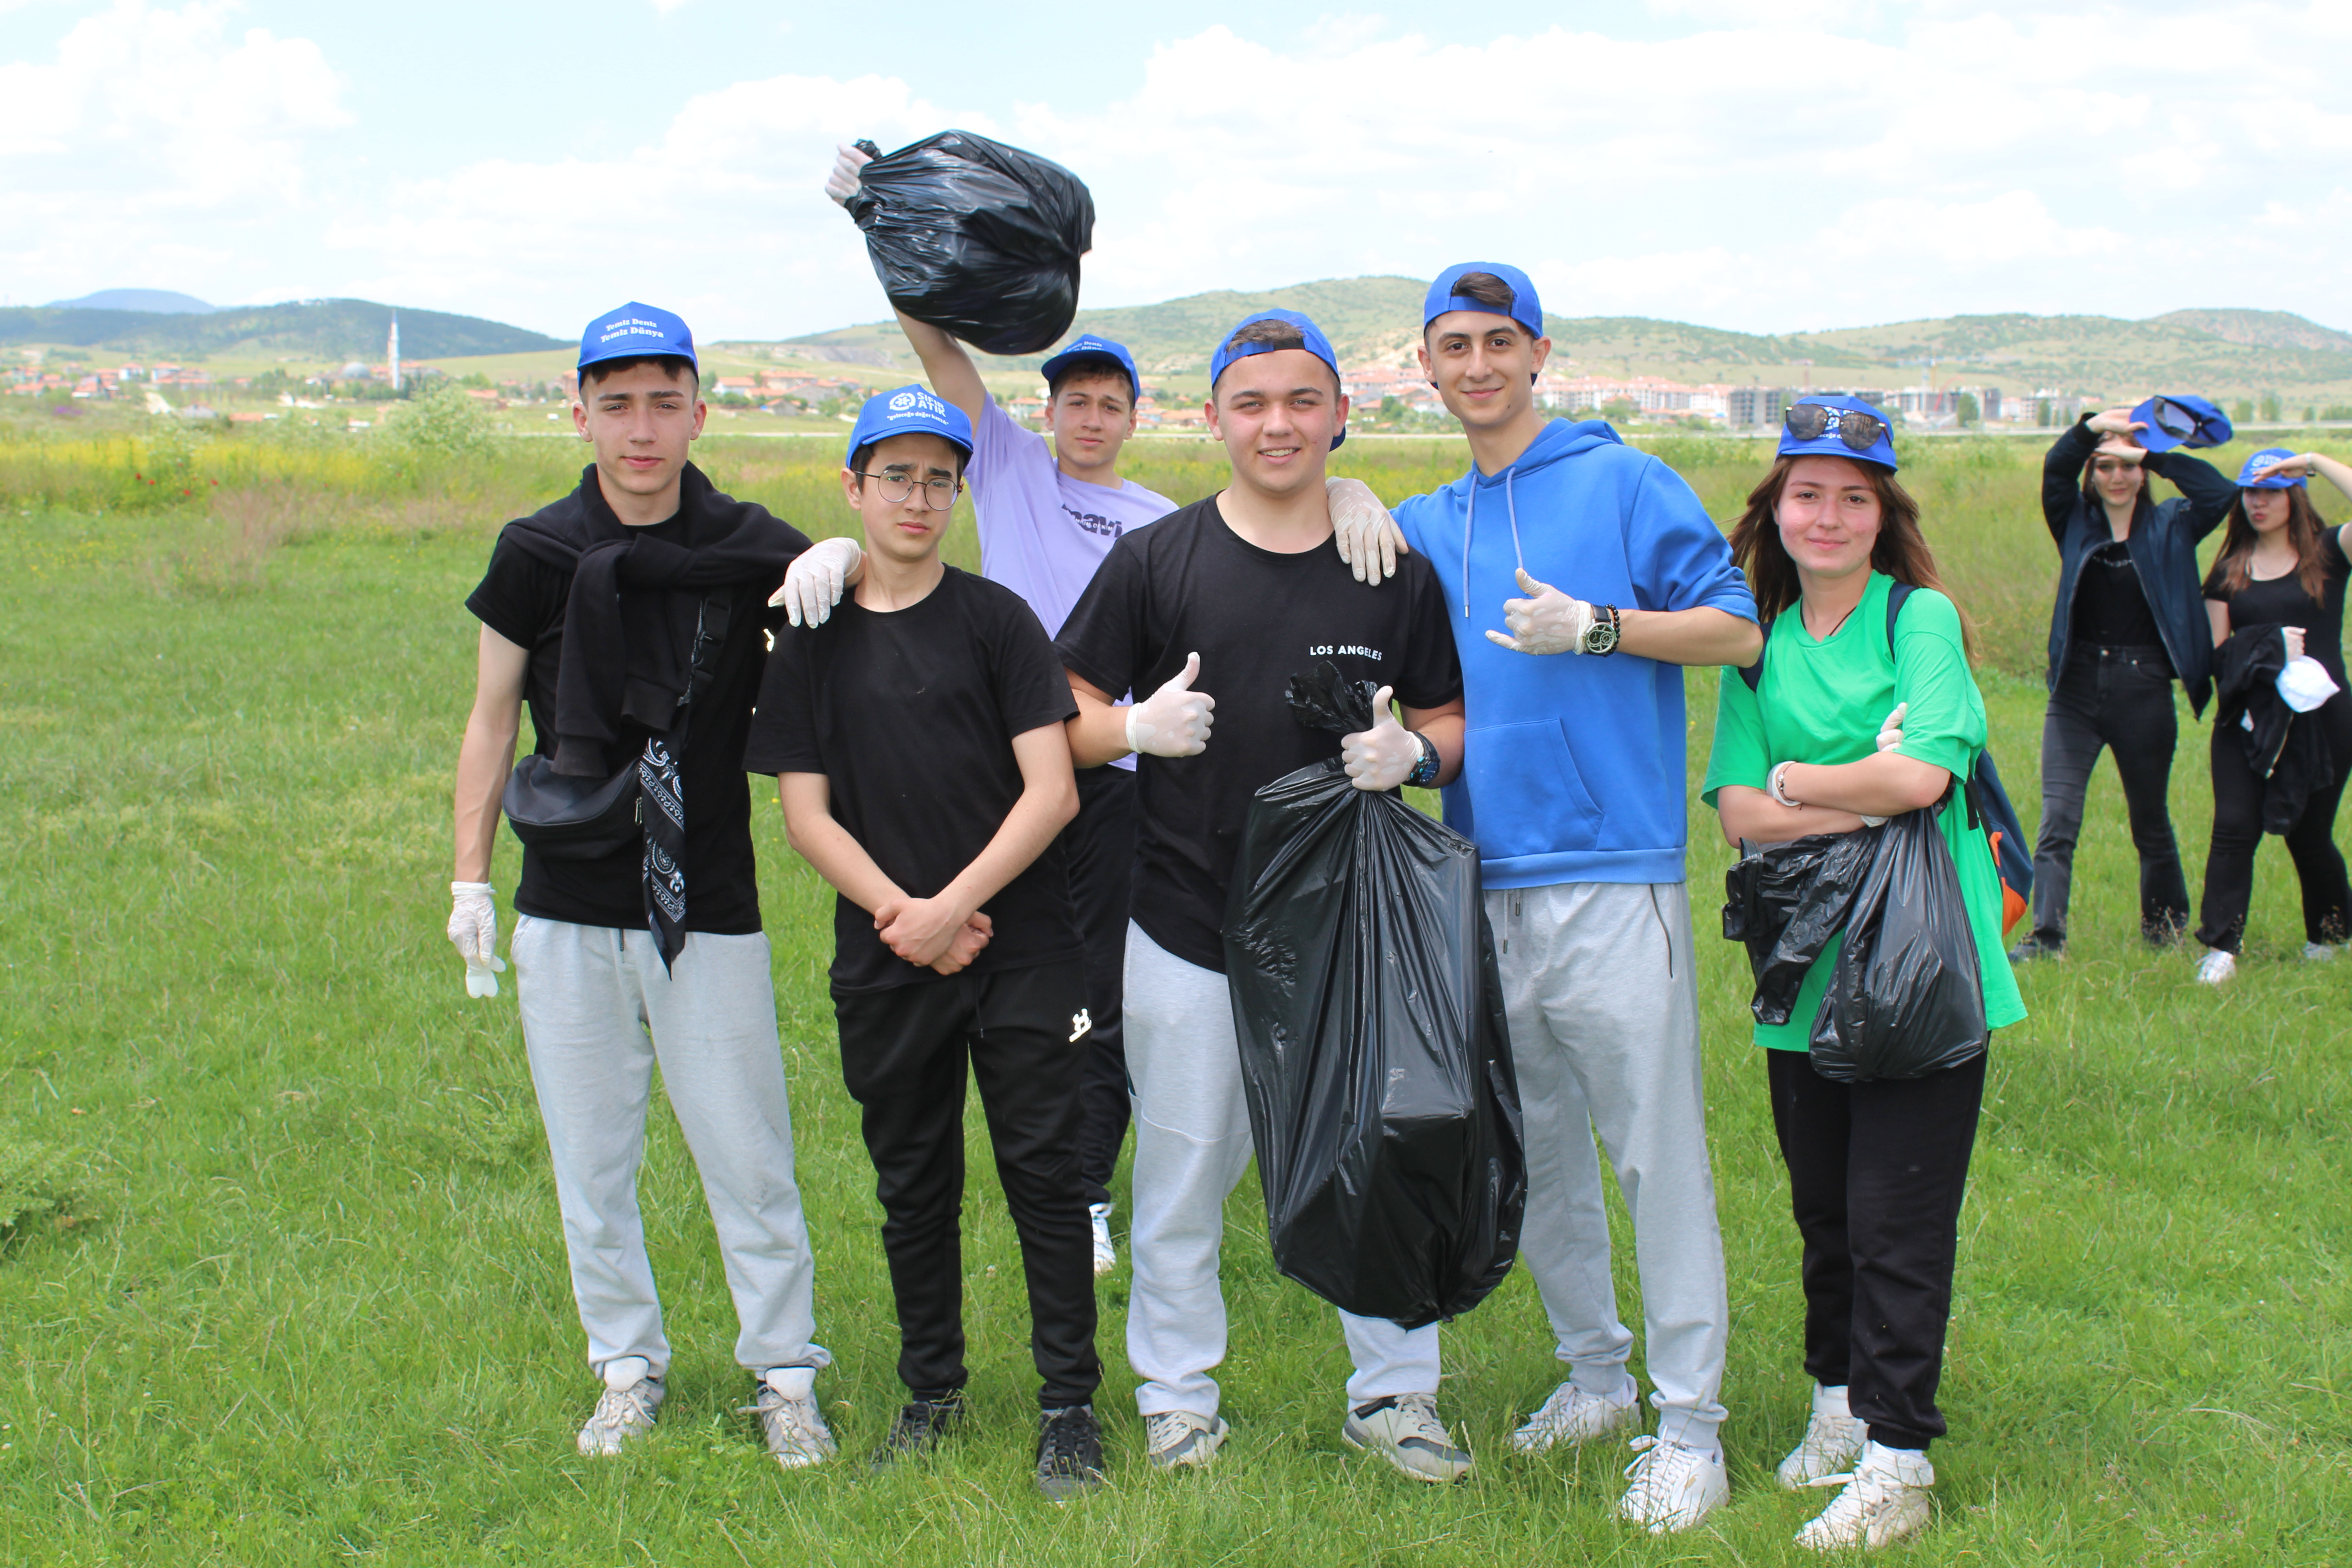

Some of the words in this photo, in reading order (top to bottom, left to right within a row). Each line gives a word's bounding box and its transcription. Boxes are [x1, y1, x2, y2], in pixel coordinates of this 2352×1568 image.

[606, 320, 630, 331] Temiz
[632, 318, 657, 328] Deniz
[601, 329, 628, 343] Temiz
[630, 327, 664, 338] Dünya
[917, 392, 945, 410] SIFIR
[918, 400, 946, 417] ATIK
[1310, 645, 1333, 656] LOS
[1338, 645, 1382, 661] ANGELES
